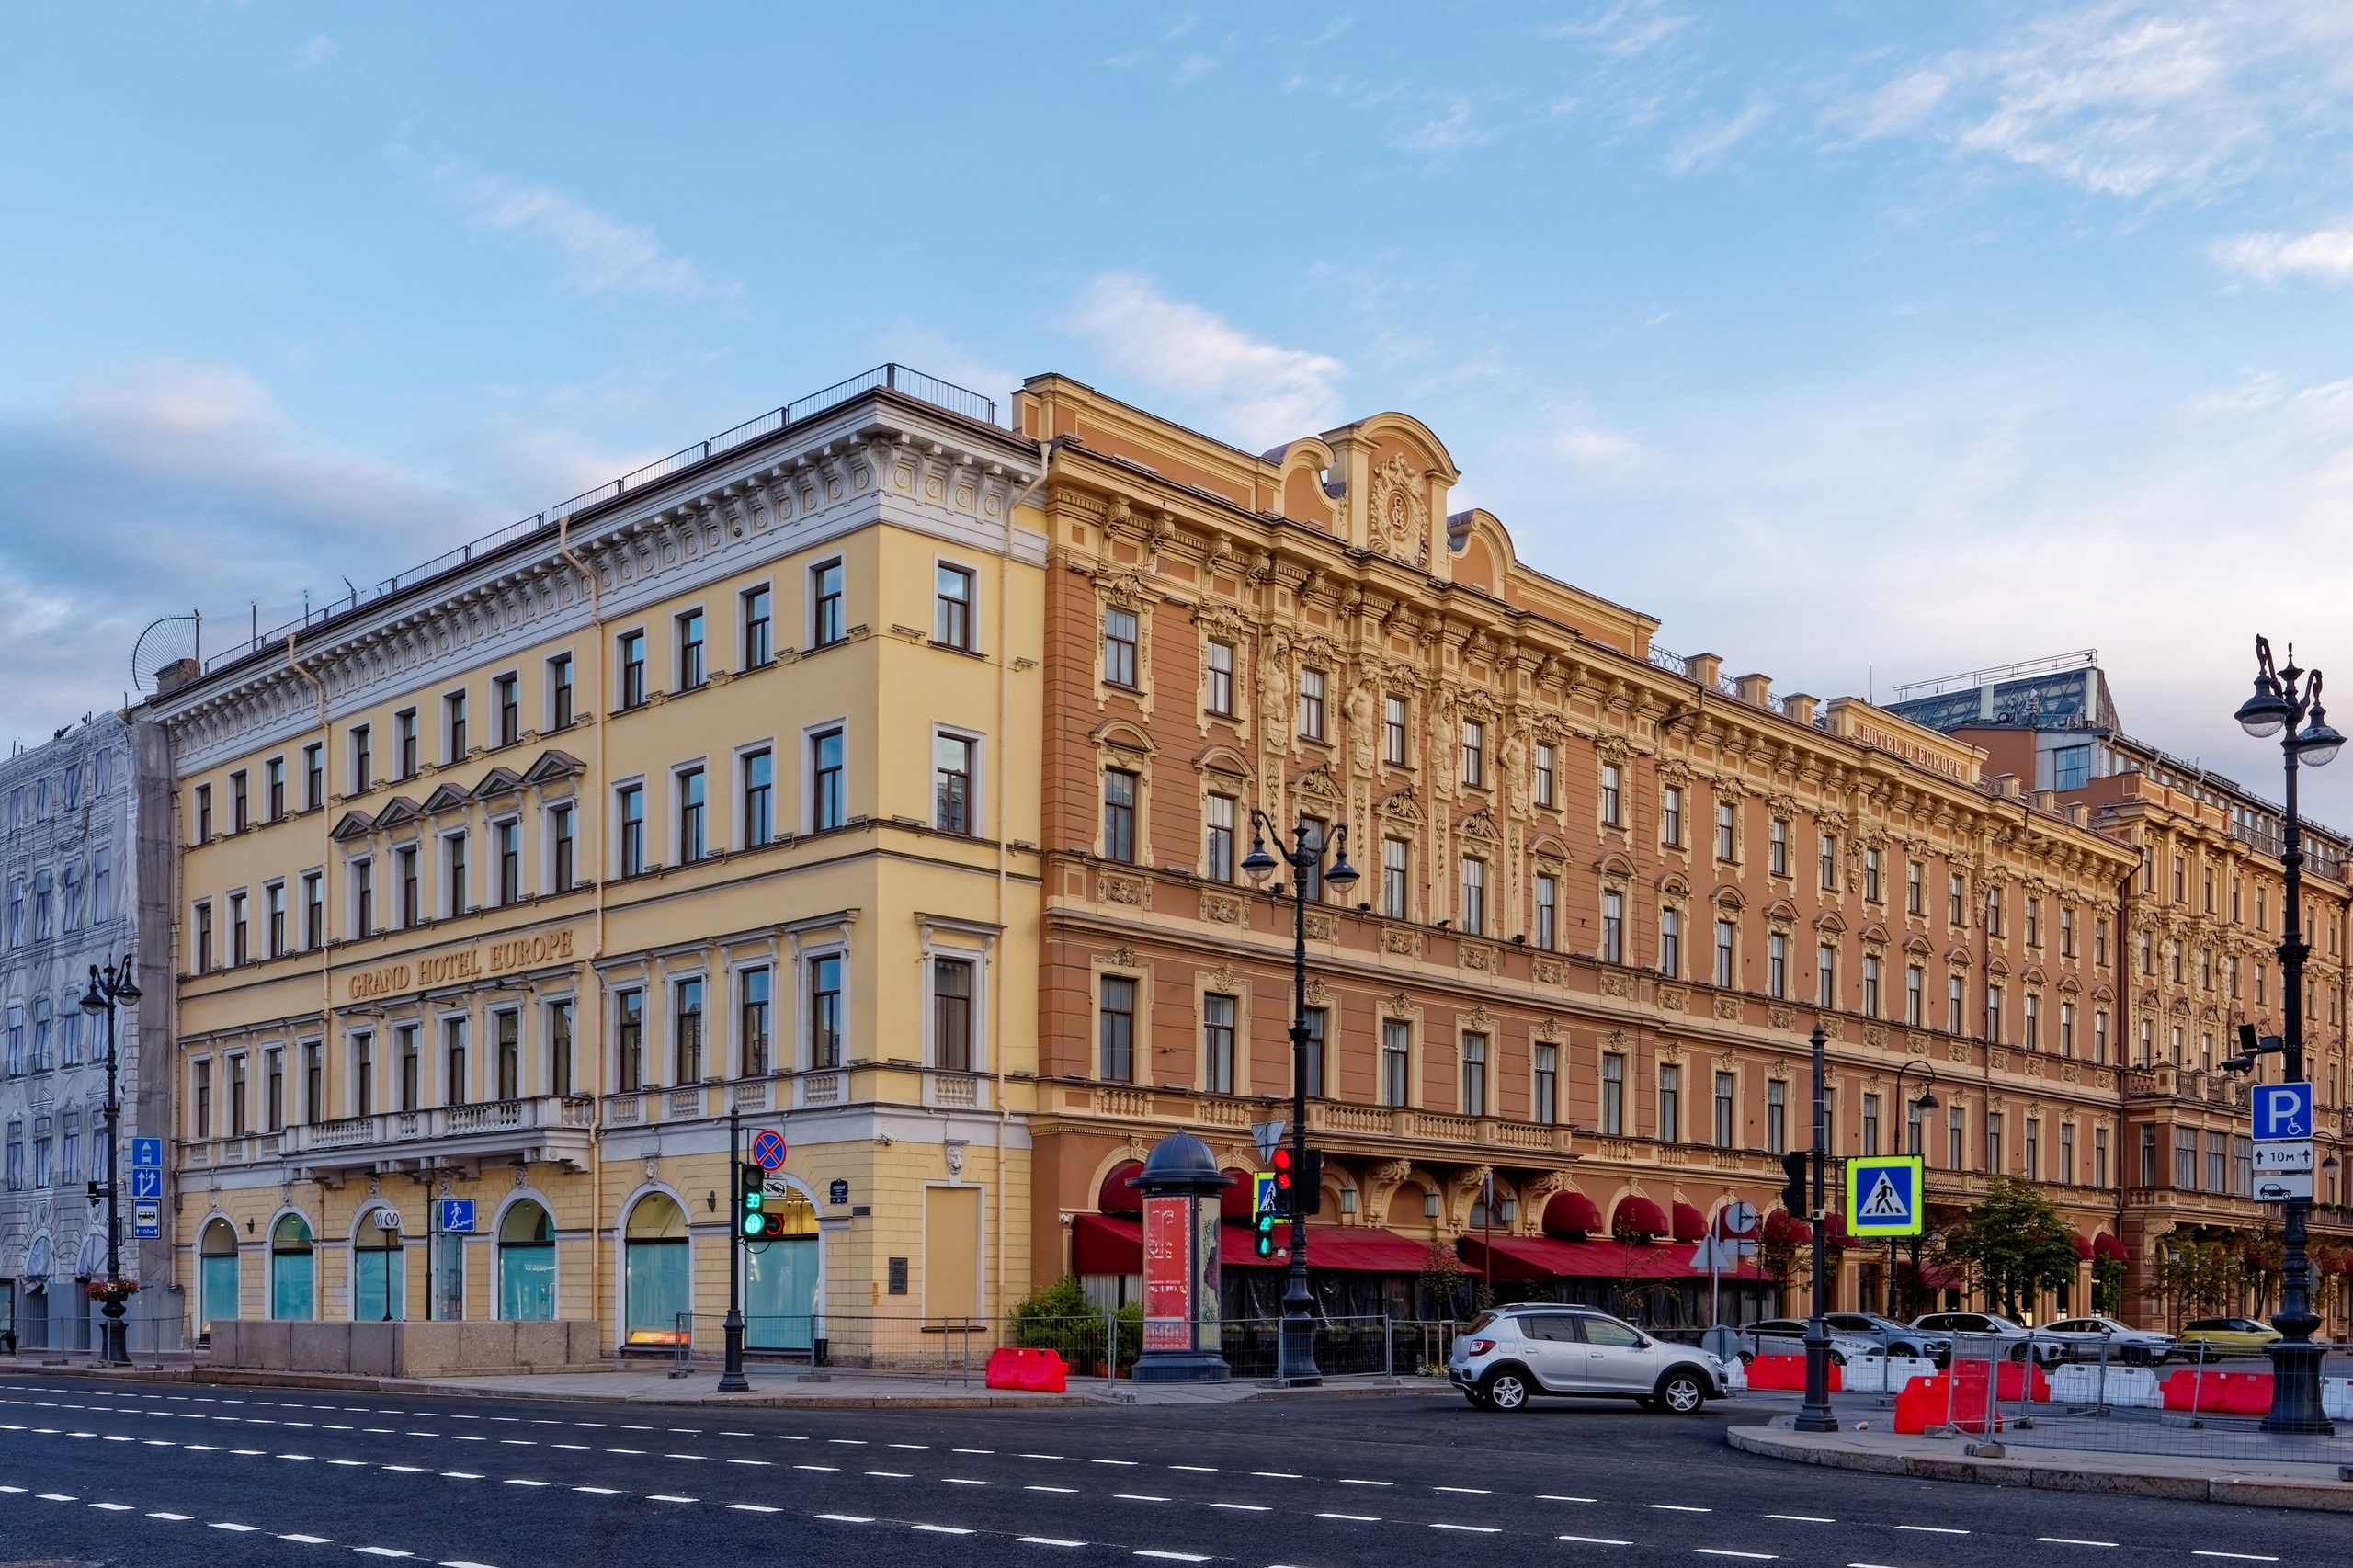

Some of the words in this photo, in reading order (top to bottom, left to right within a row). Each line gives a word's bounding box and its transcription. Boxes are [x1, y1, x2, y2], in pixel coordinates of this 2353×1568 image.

[1861, 724, 1901, 755] HOTEL
[1917, 747, 1961, 778] EUROPE
[348, 964, 410, 999] GRAND
[417, 949, 482, 985] HOTEL
[489, 929, 574, 971] EUROPE
[2269, 1090, 2301, 1133] P
[2270, 1151, 2295, 1163] 10м
